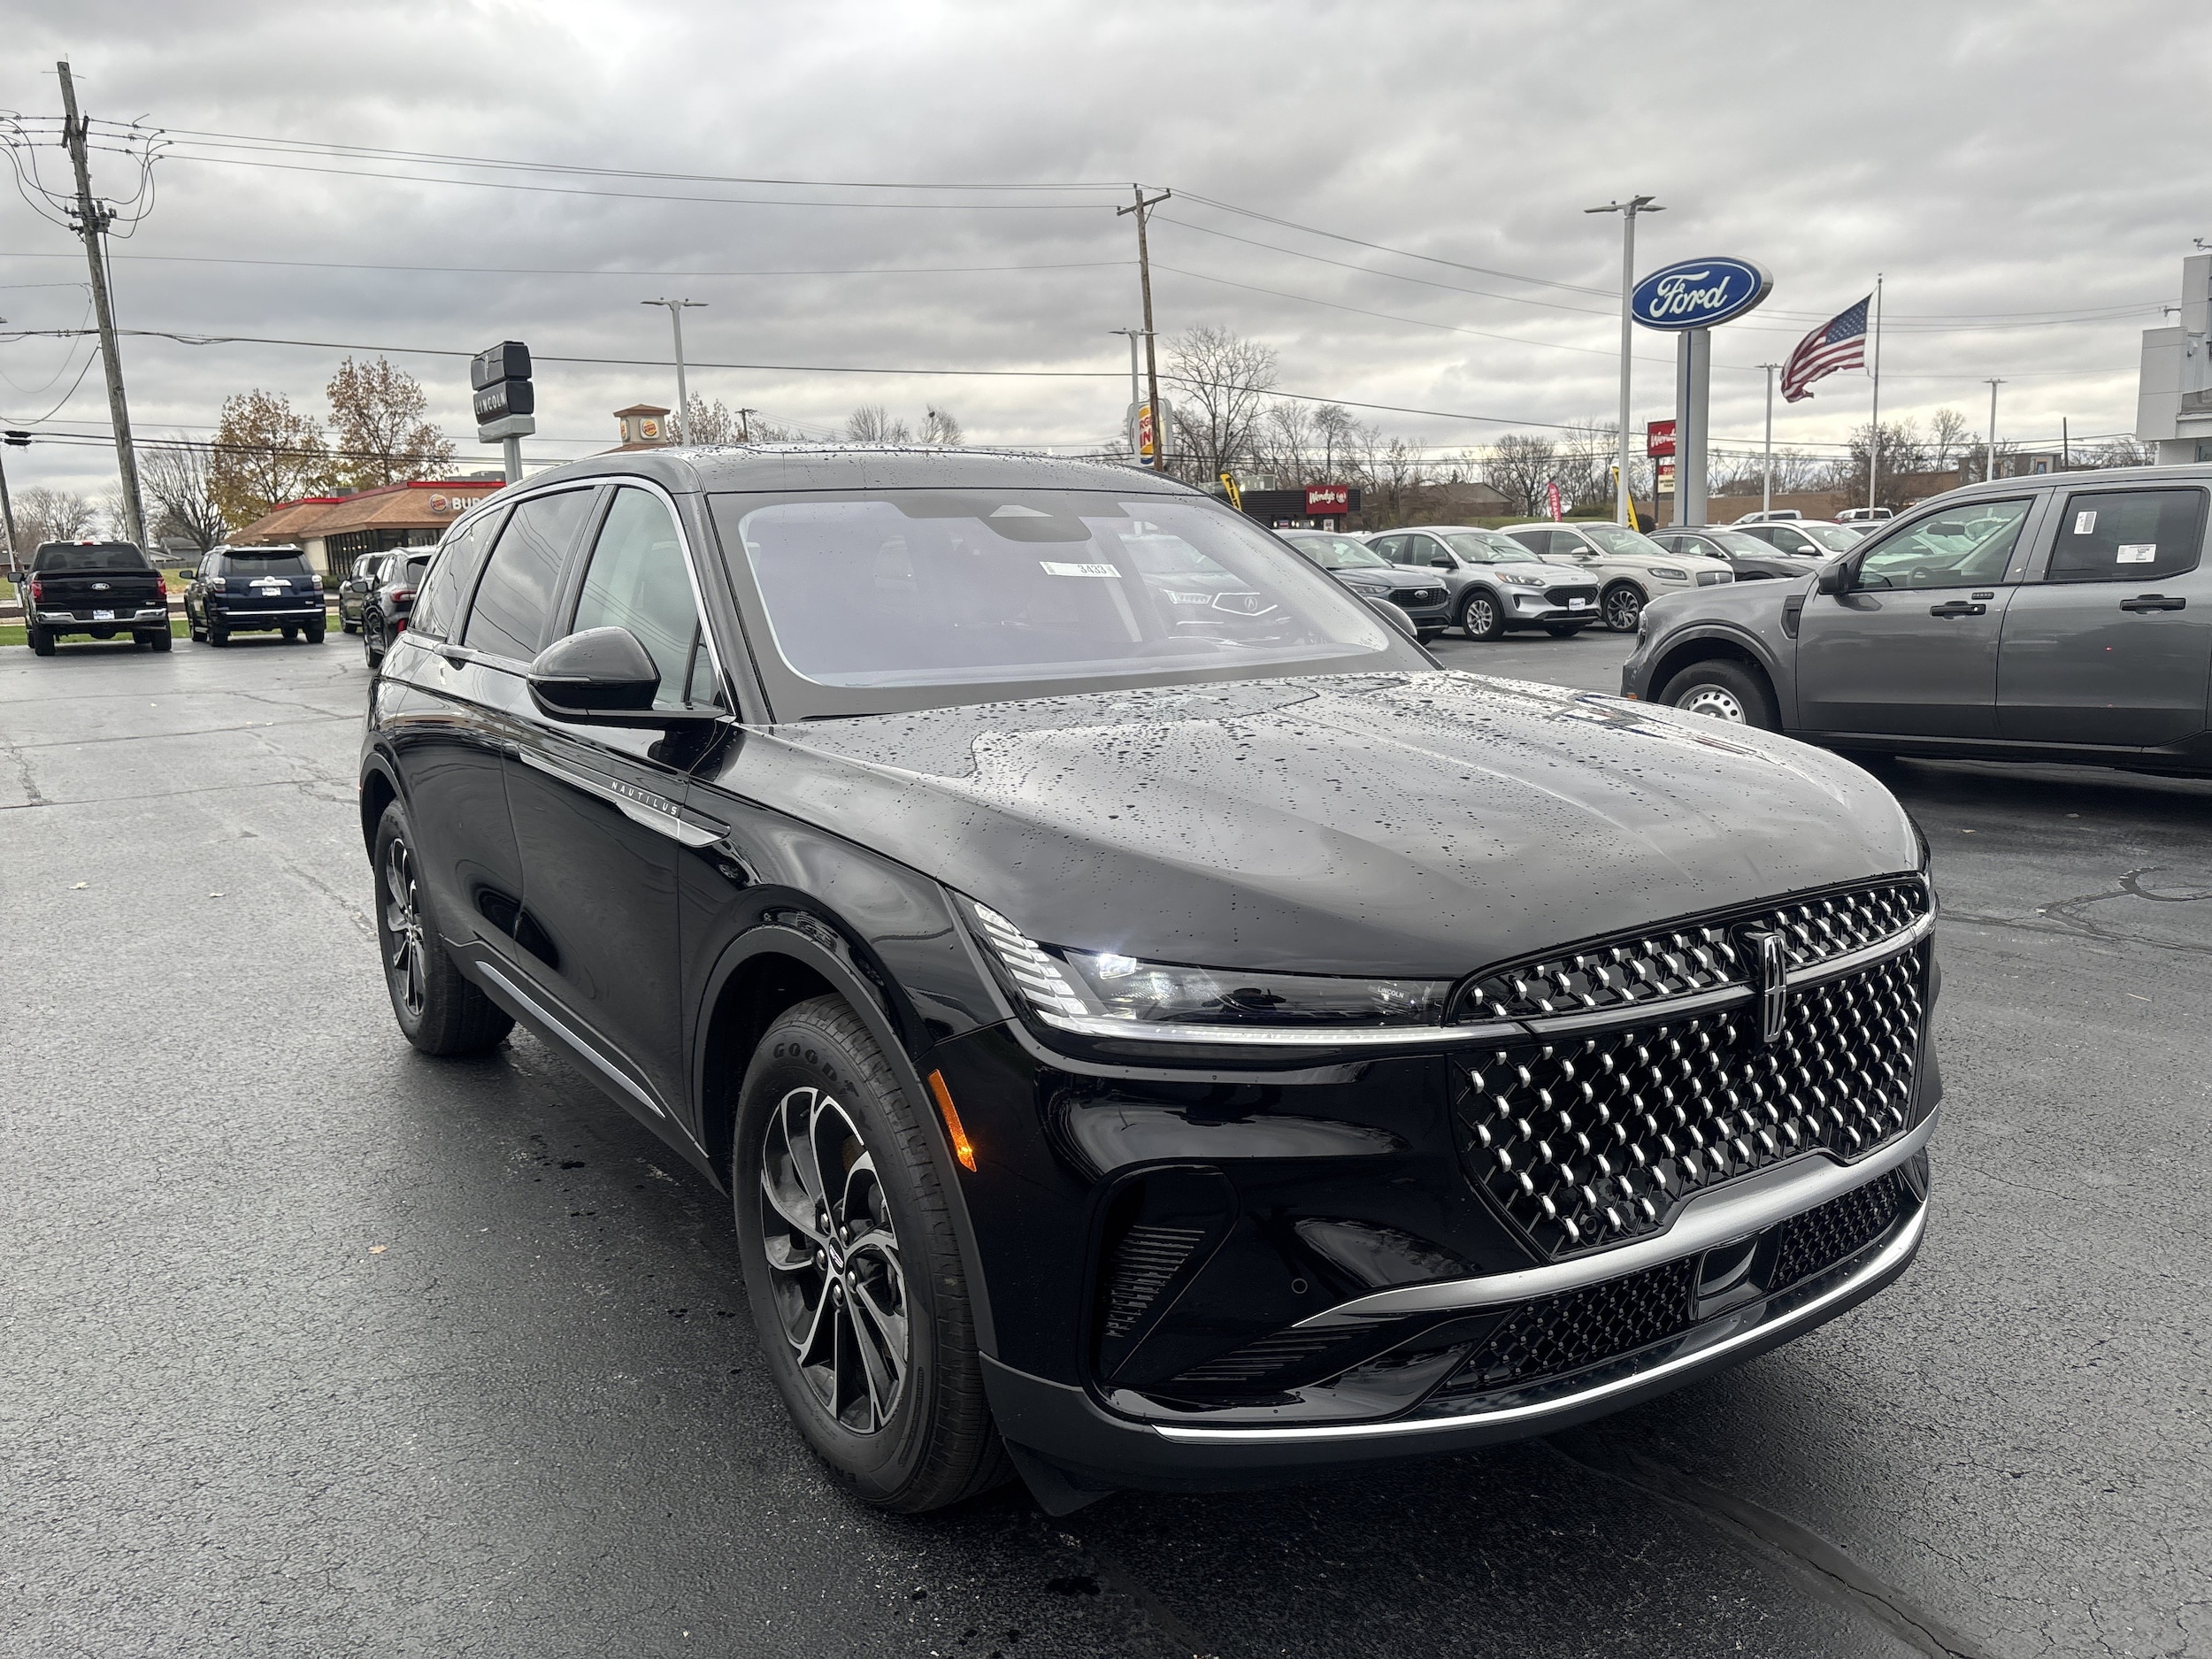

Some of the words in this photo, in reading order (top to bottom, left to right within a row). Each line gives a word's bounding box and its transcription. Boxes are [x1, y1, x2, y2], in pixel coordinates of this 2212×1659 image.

[1649, 271, 1731, 318] Ford
[475, 392, 506, 415] LINCOLN
[1650, 427, 1677, 449] Wend
[1309, 489, 1335, 505] Wendy's
[611, 781, 678, 815] NAUTILUS
[1378, 987, 1404, 999] LINCOLN
